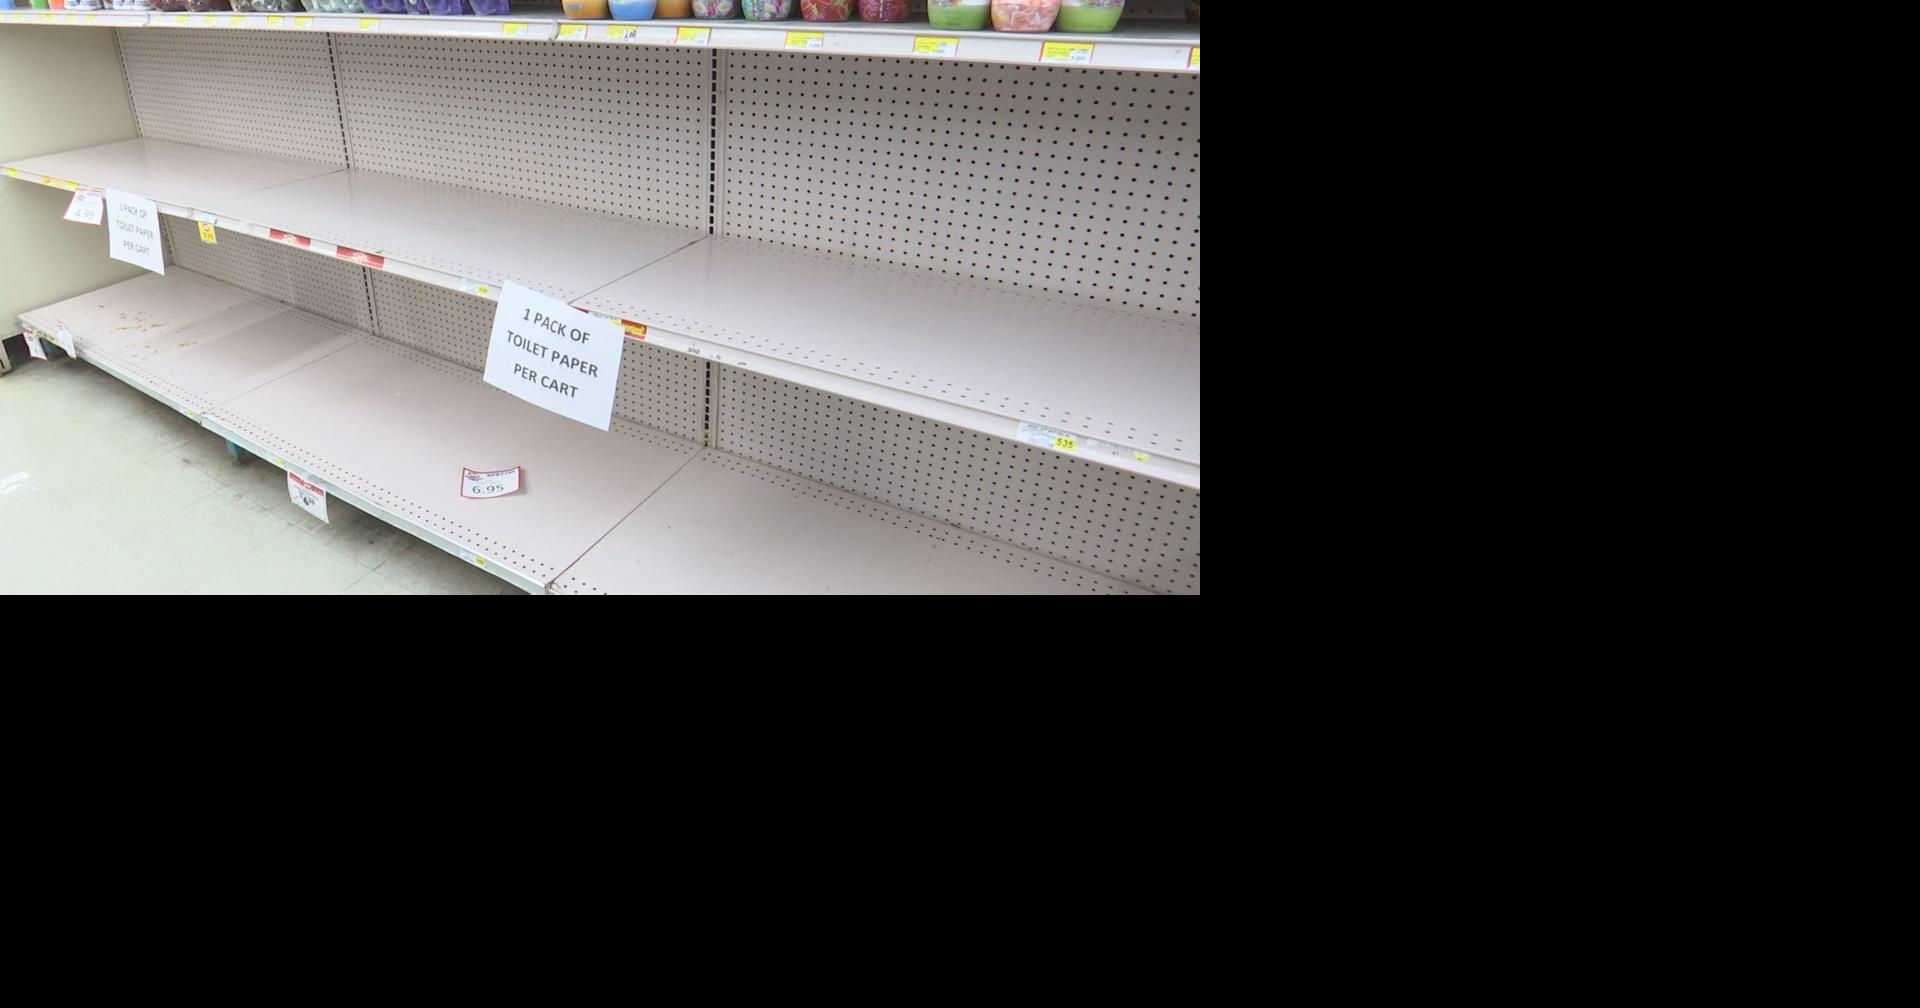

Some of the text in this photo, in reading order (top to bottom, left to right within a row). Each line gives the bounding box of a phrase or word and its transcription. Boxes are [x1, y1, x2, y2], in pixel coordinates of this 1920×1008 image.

[123, 204, 138, 215] PACK
[139, 208, 148, 218] OF
[116, 219, 154, 239] TOILET PAPER
[123, 239, 150, 256] PER CART
[522, 308, 591, 344] 1 PACK OF
[506, 330, 598, 378] TOILET PAPER
[513, 363, 579, 399] PER CART
[1056, 438, 1074, 449] 535
[472, 484, 504, 494] 6.95
